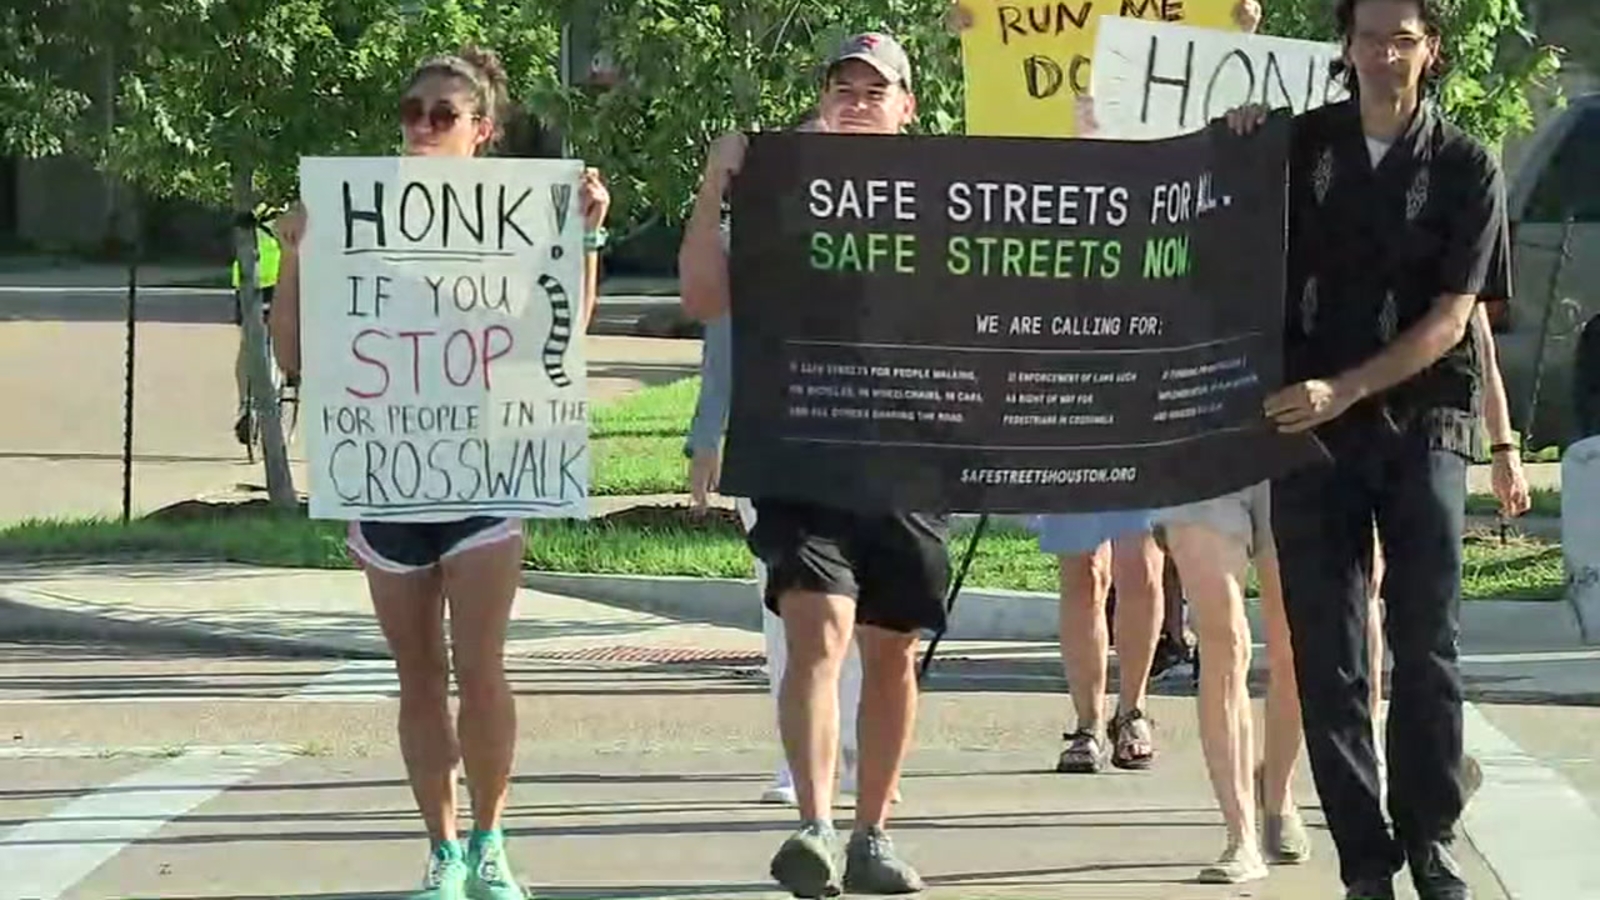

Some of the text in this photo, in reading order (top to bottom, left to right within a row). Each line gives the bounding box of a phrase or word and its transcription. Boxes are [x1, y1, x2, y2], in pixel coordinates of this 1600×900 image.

[998, 0, 1185, 45] RUN ME
[808, 178, 917, 220] SAFE
[947, 182, 1129, 227] STREETS
[1151, 181, 1191, 224] FOR
[809, 231, 917, 274] SAFE
[946, 235, 1121, 279] STREETS
[347, 276, 512, 317] IF YOU
[976, 314, 999, 334] WE
[1010, 315, 1042, 335] ARE
[1051, 316, 1121, 336] CALLING
[346, 325, 514, 398] STOP
[893, 367, 930, 379] PEOPLE
[323, 399, 587, 434] FOR PEOPLE IN THE
[329, 438, 586, 504] CROSSWALK
[960, 468, 1136, 484] SAFESTREETSHOUSTON.ORG
